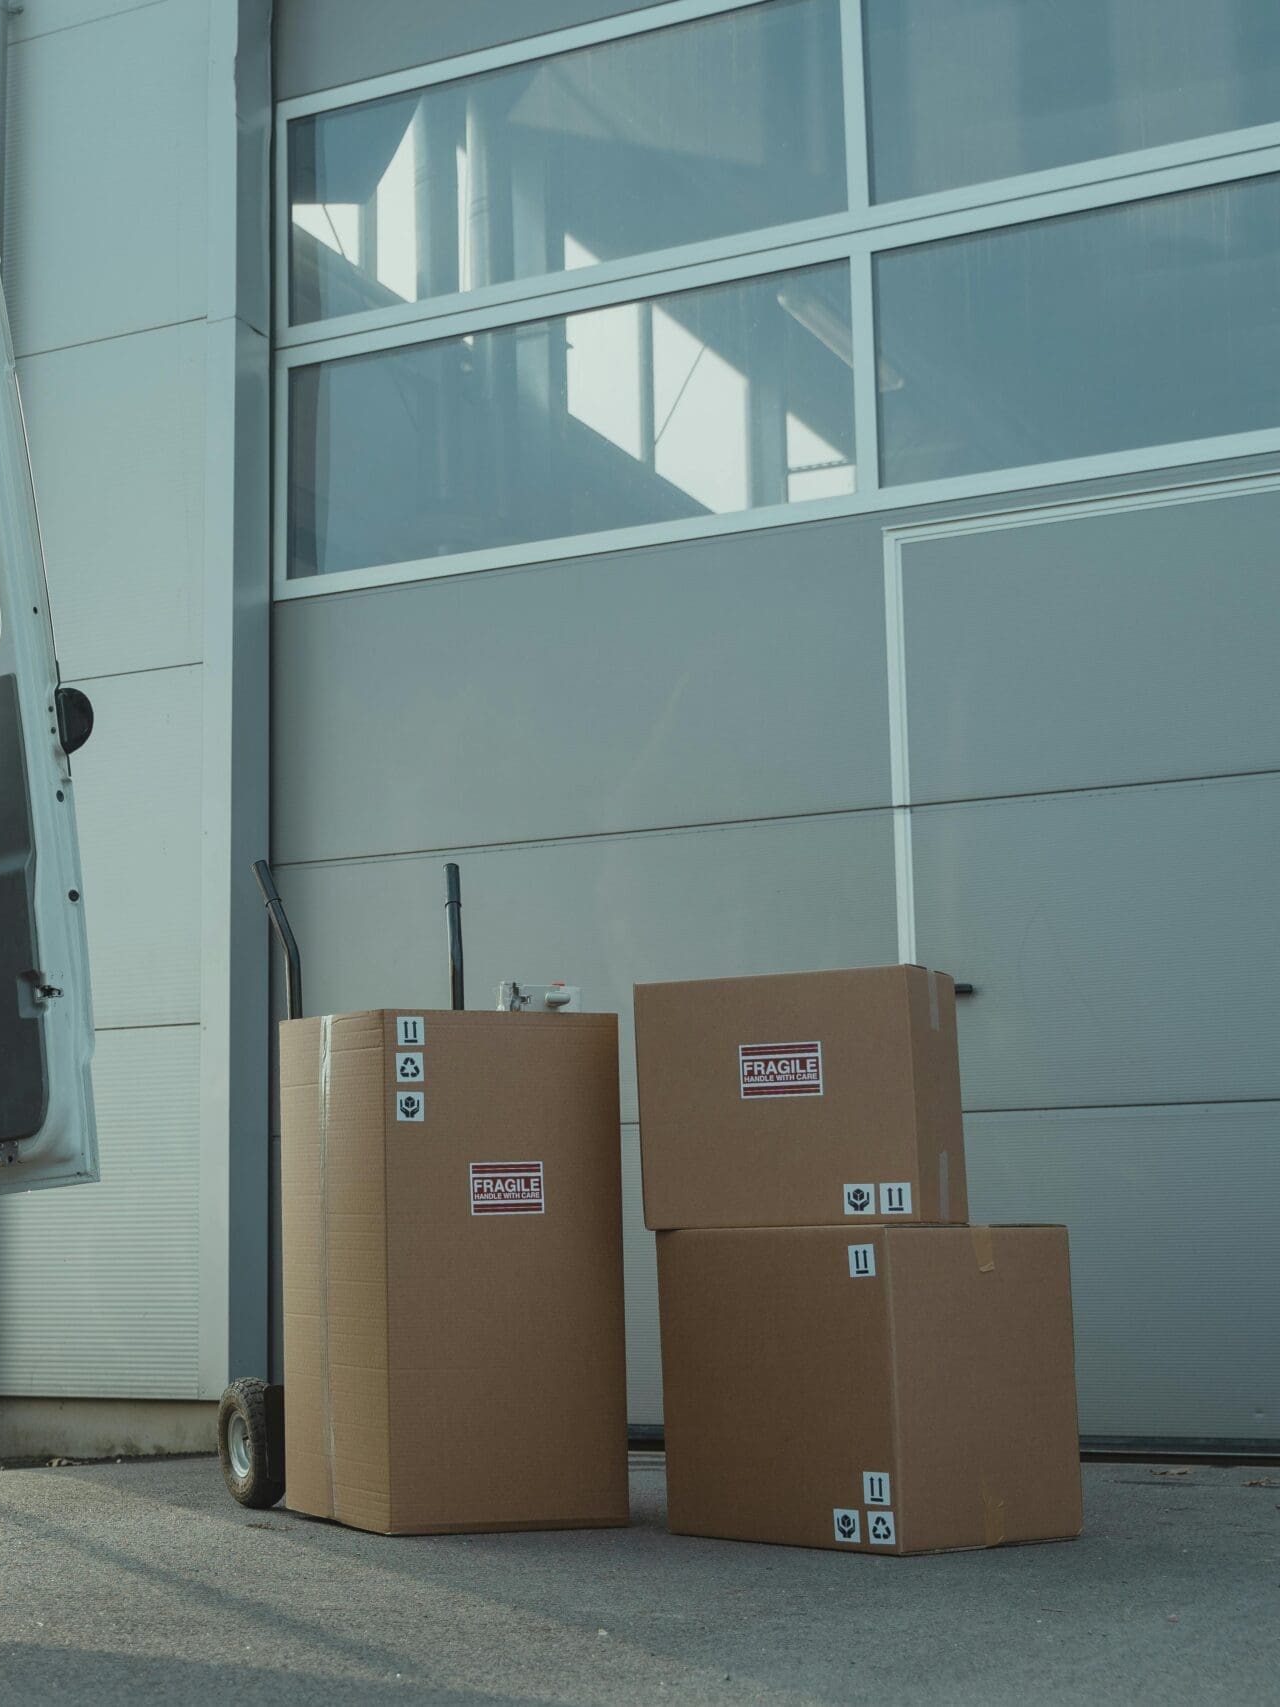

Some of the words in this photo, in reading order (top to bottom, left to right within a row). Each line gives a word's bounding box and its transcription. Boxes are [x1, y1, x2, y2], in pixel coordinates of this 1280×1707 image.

[743, 1059, 818, 1075] FRAGILE
[744, 1074, 774, 1082] HANDLE
[775, 1073, 795, 1081] WITH
[796, 1073, 818, 1081] CARE
[473, 1178, 540, 1193] FRAGILE
[474, 1192, 503, 1200] HANDLE
[521, 1191, 540, 1199] CARE
